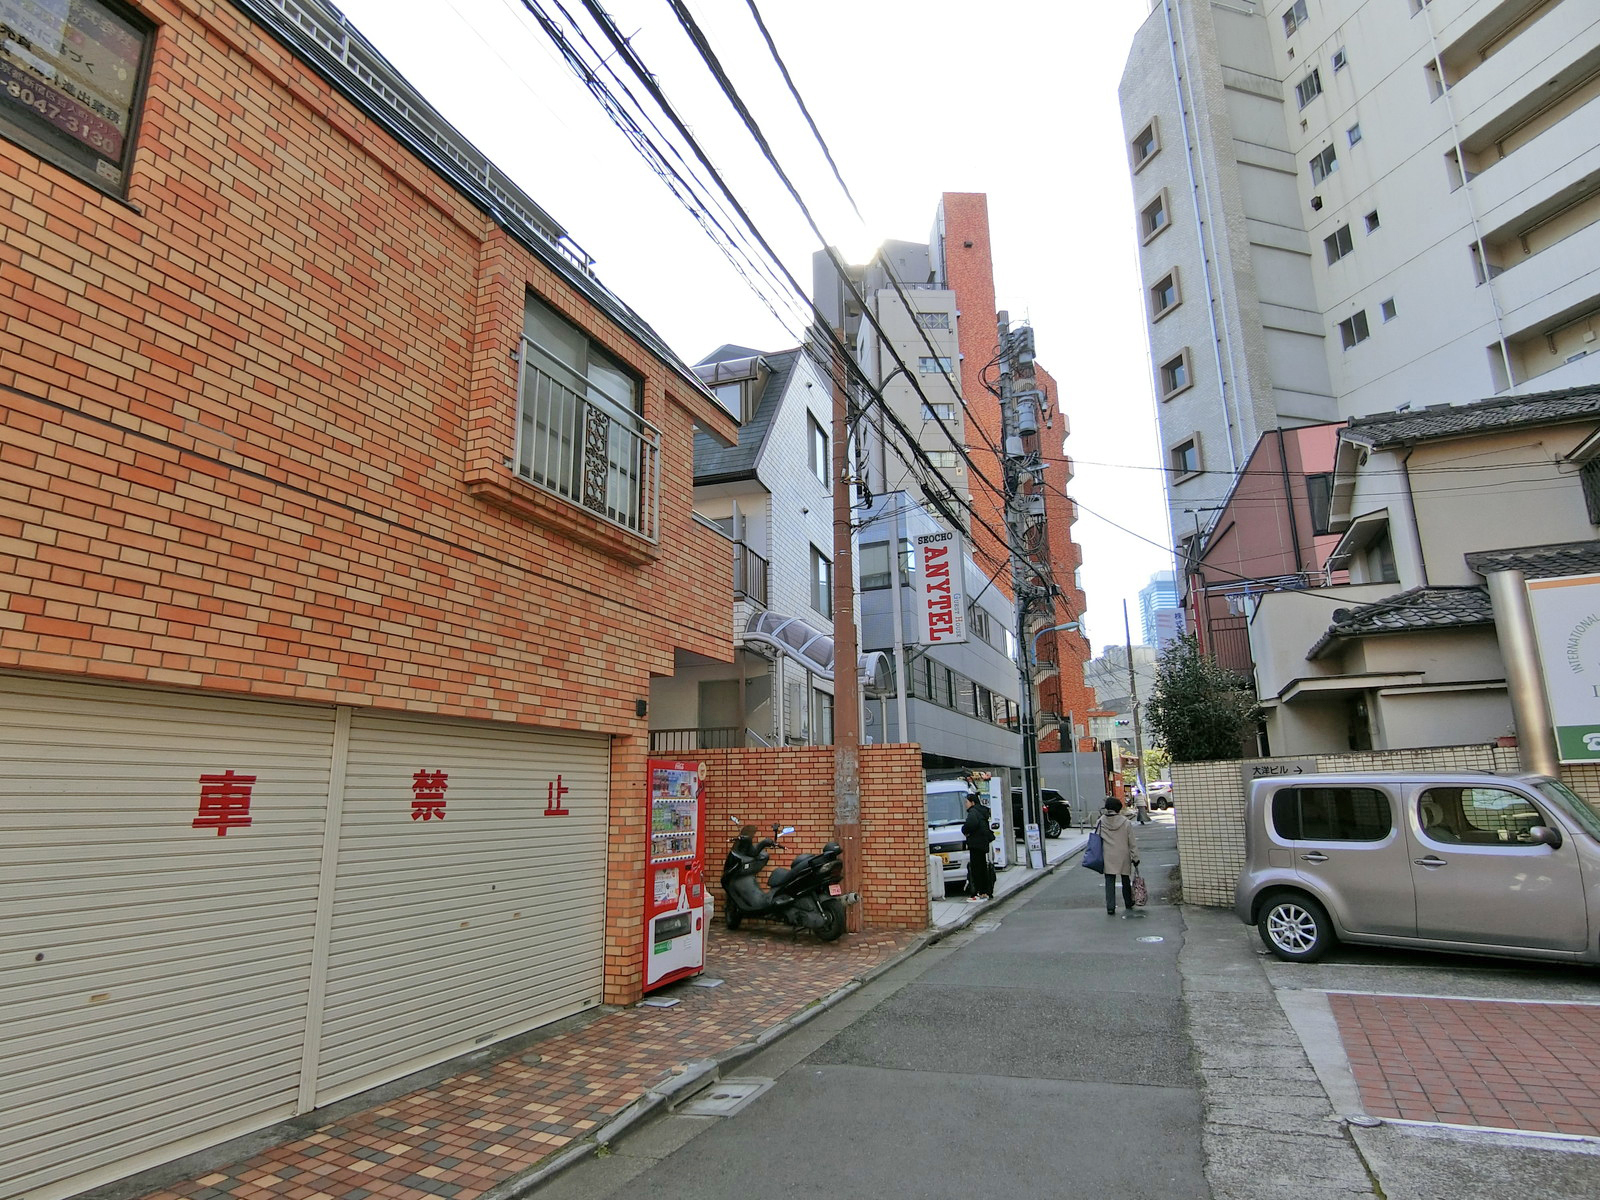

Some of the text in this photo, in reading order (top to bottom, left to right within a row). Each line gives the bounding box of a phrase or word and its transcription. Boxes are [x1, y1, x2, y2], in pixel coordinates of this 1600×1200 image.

[918, 532, 953, 545] SEOCHO
[924, 546, 953, 641] ANYTEL
[1567, 612, 1600, 675] INTERNATIONAL
[1252, 765, 1289, 776] 大洋ビル
[192, 769, 569, 836] 車 禁 止
